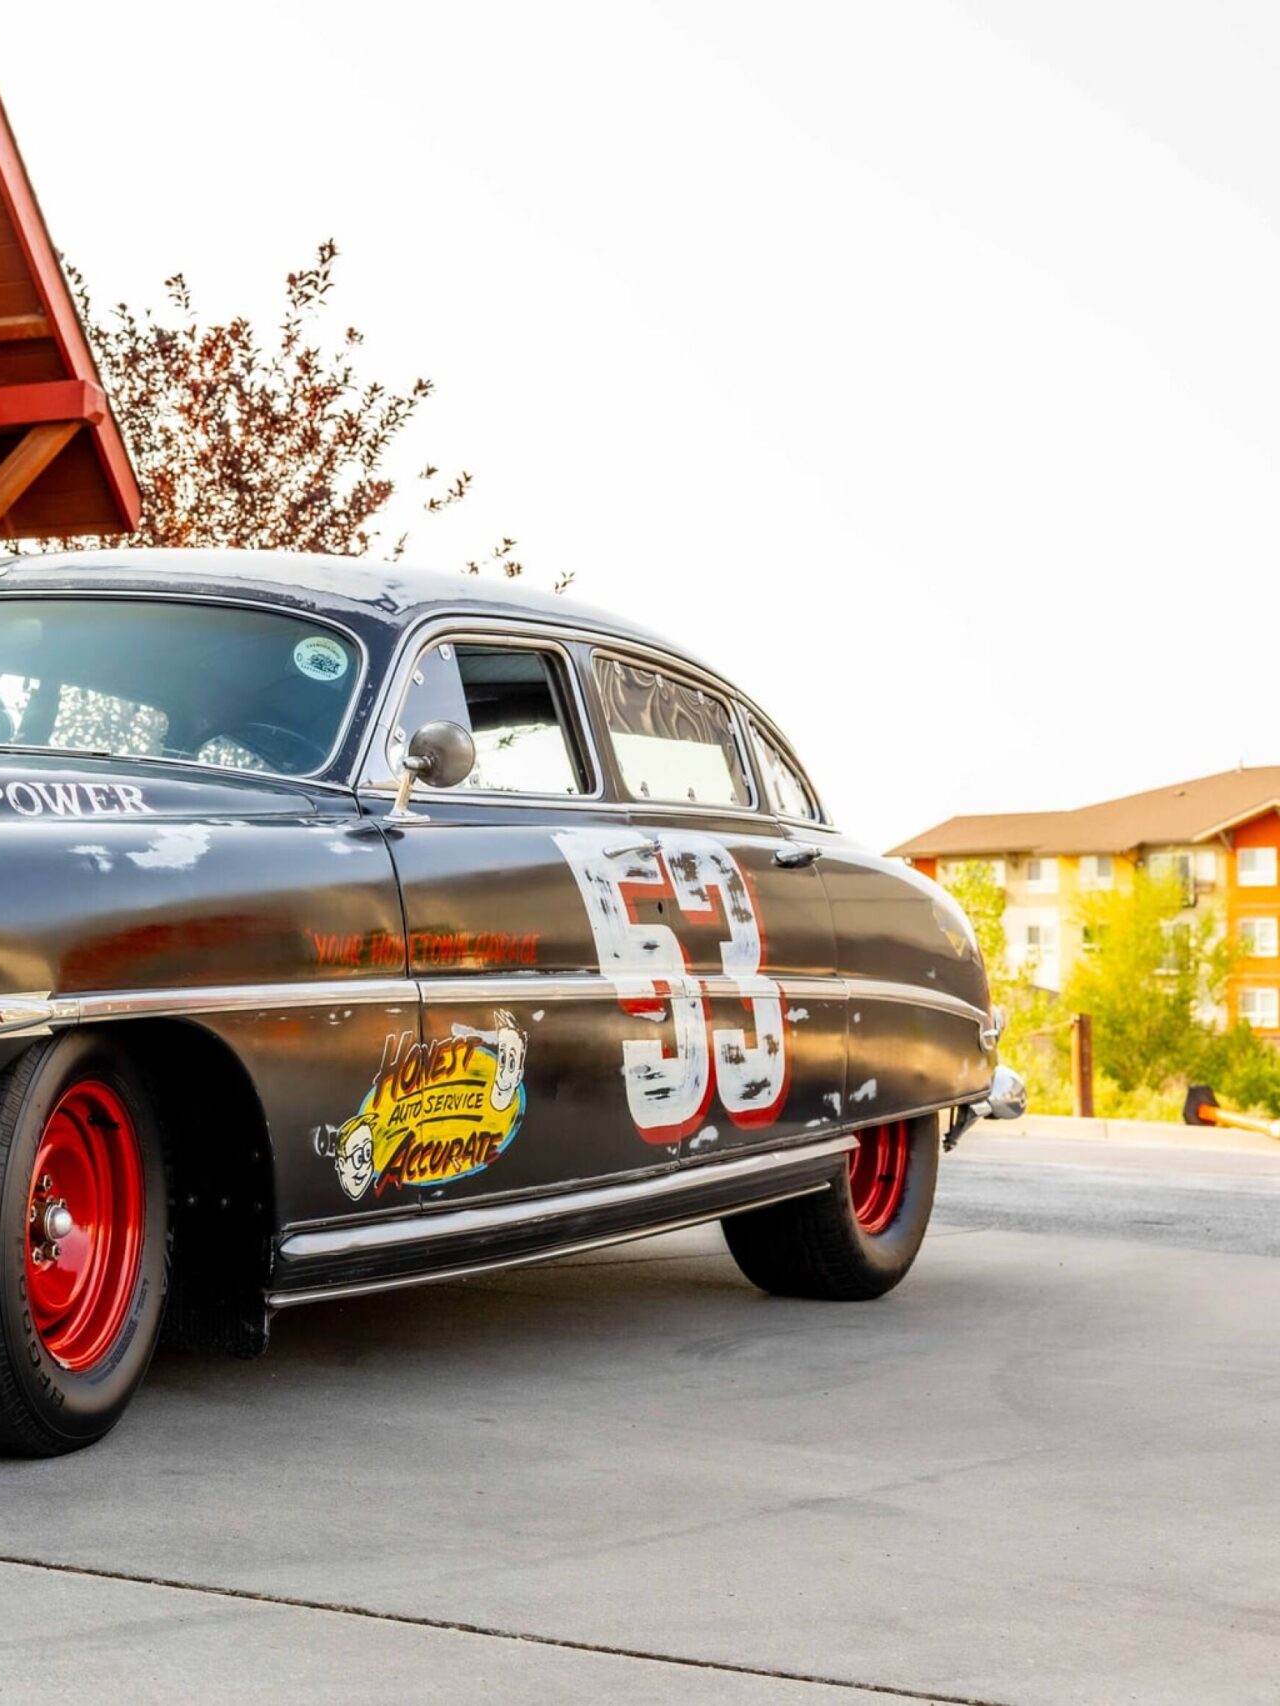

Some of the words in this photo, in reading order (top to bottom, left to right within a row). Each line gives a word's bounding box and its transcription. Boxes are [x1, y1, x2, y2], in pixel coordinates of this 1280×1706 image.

[551, 826, 792, 1143] 53
[373, 1031, 485, 1111] HONEST
[387, 1100, 422, 1128] AUTO
[423, 1092, 484, 1115] SERVICE
[374, 1130, 504, 1198] ACCURATE
